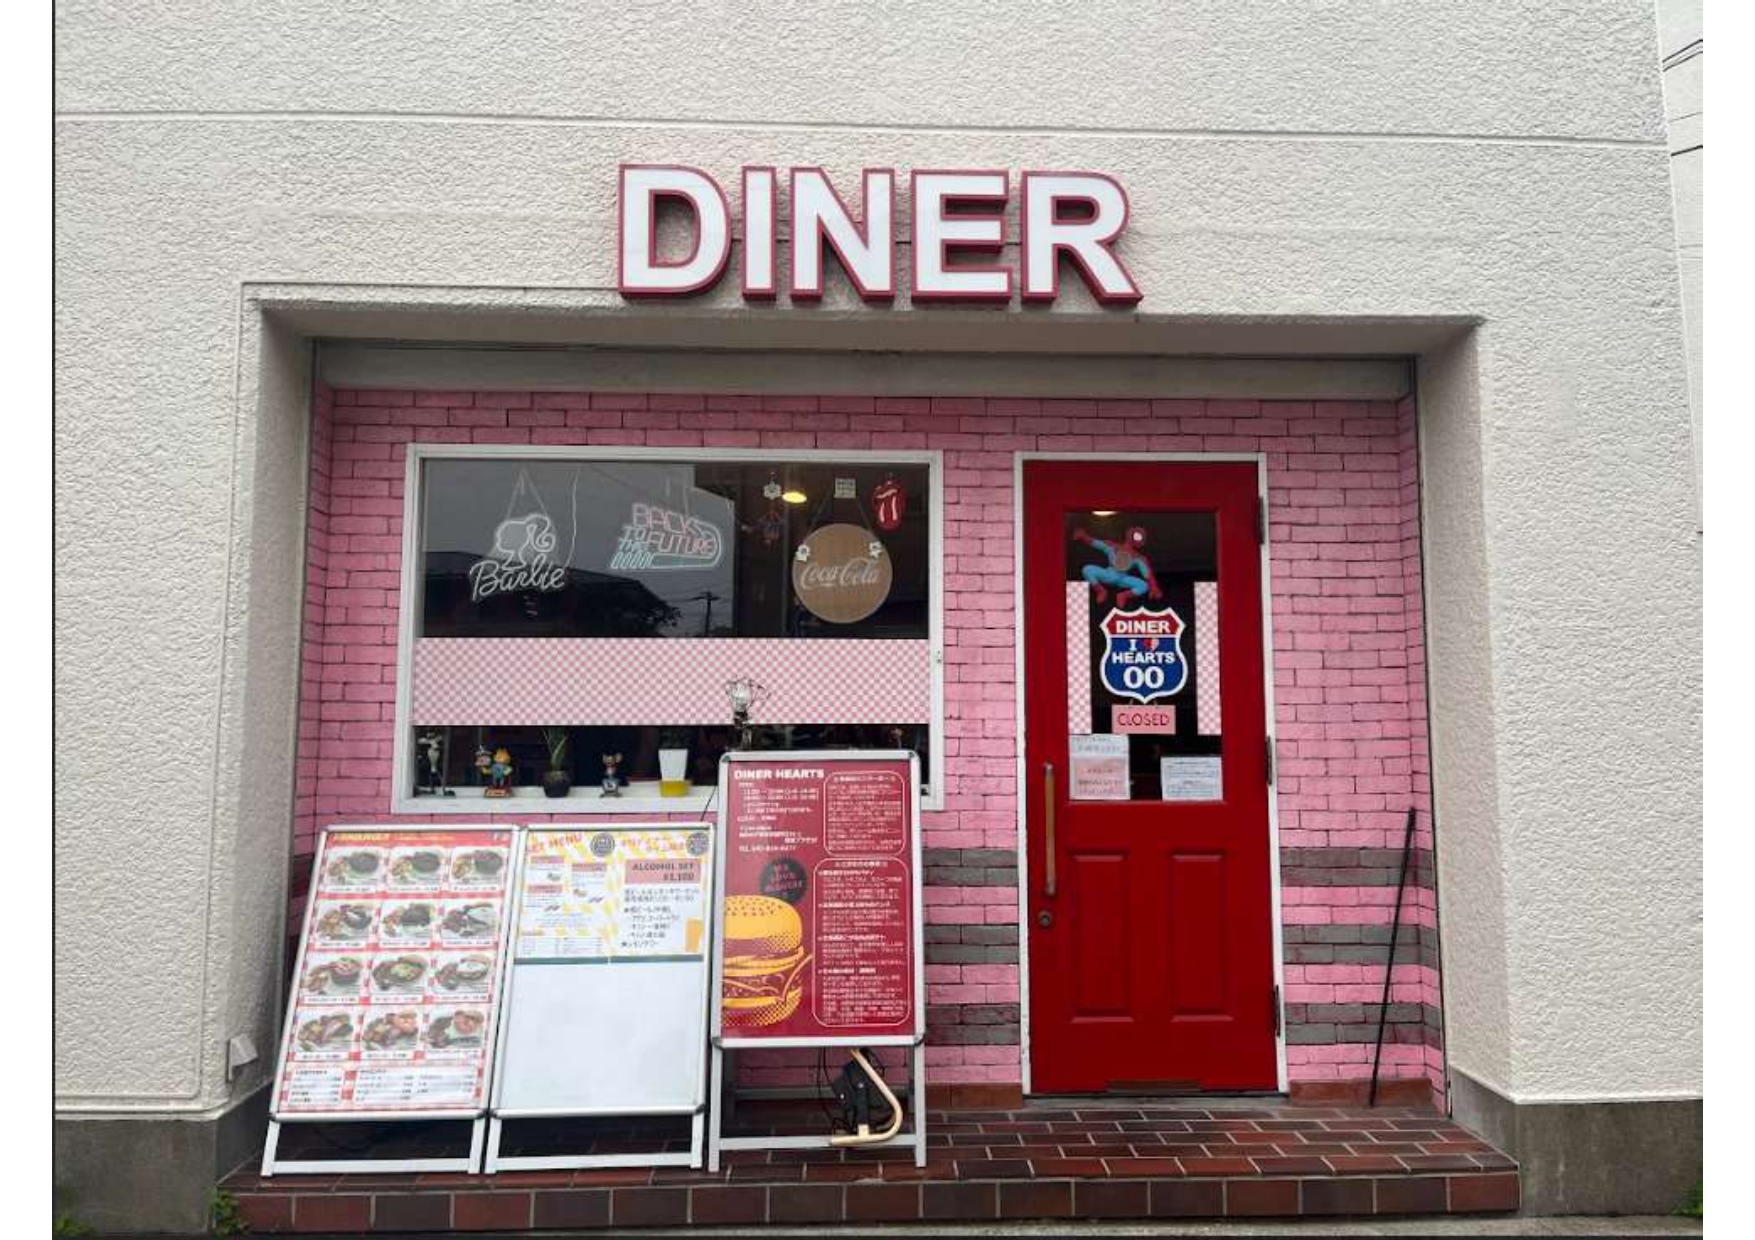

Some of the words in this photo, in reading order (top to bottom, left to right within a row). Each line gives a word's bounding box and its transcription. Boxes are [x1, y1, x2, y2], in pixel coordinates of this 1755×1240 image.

[618, 163, 1144, 302] DINER
[632, 502, 698, 537] BACK
[647, 531, 714, 555] FUTURE
[469, 553, 565, 601] Barbie
[1116, 620, 1171, 634] DINER
[1129, 639, 1137, 651] I
[1112, 652, 1175, 664] HEARTS
[1117, 712, 1170, 726] CLOSED
[734, 768, 772, 779] DINER
[776, 768, 825, 779] HEARTS
